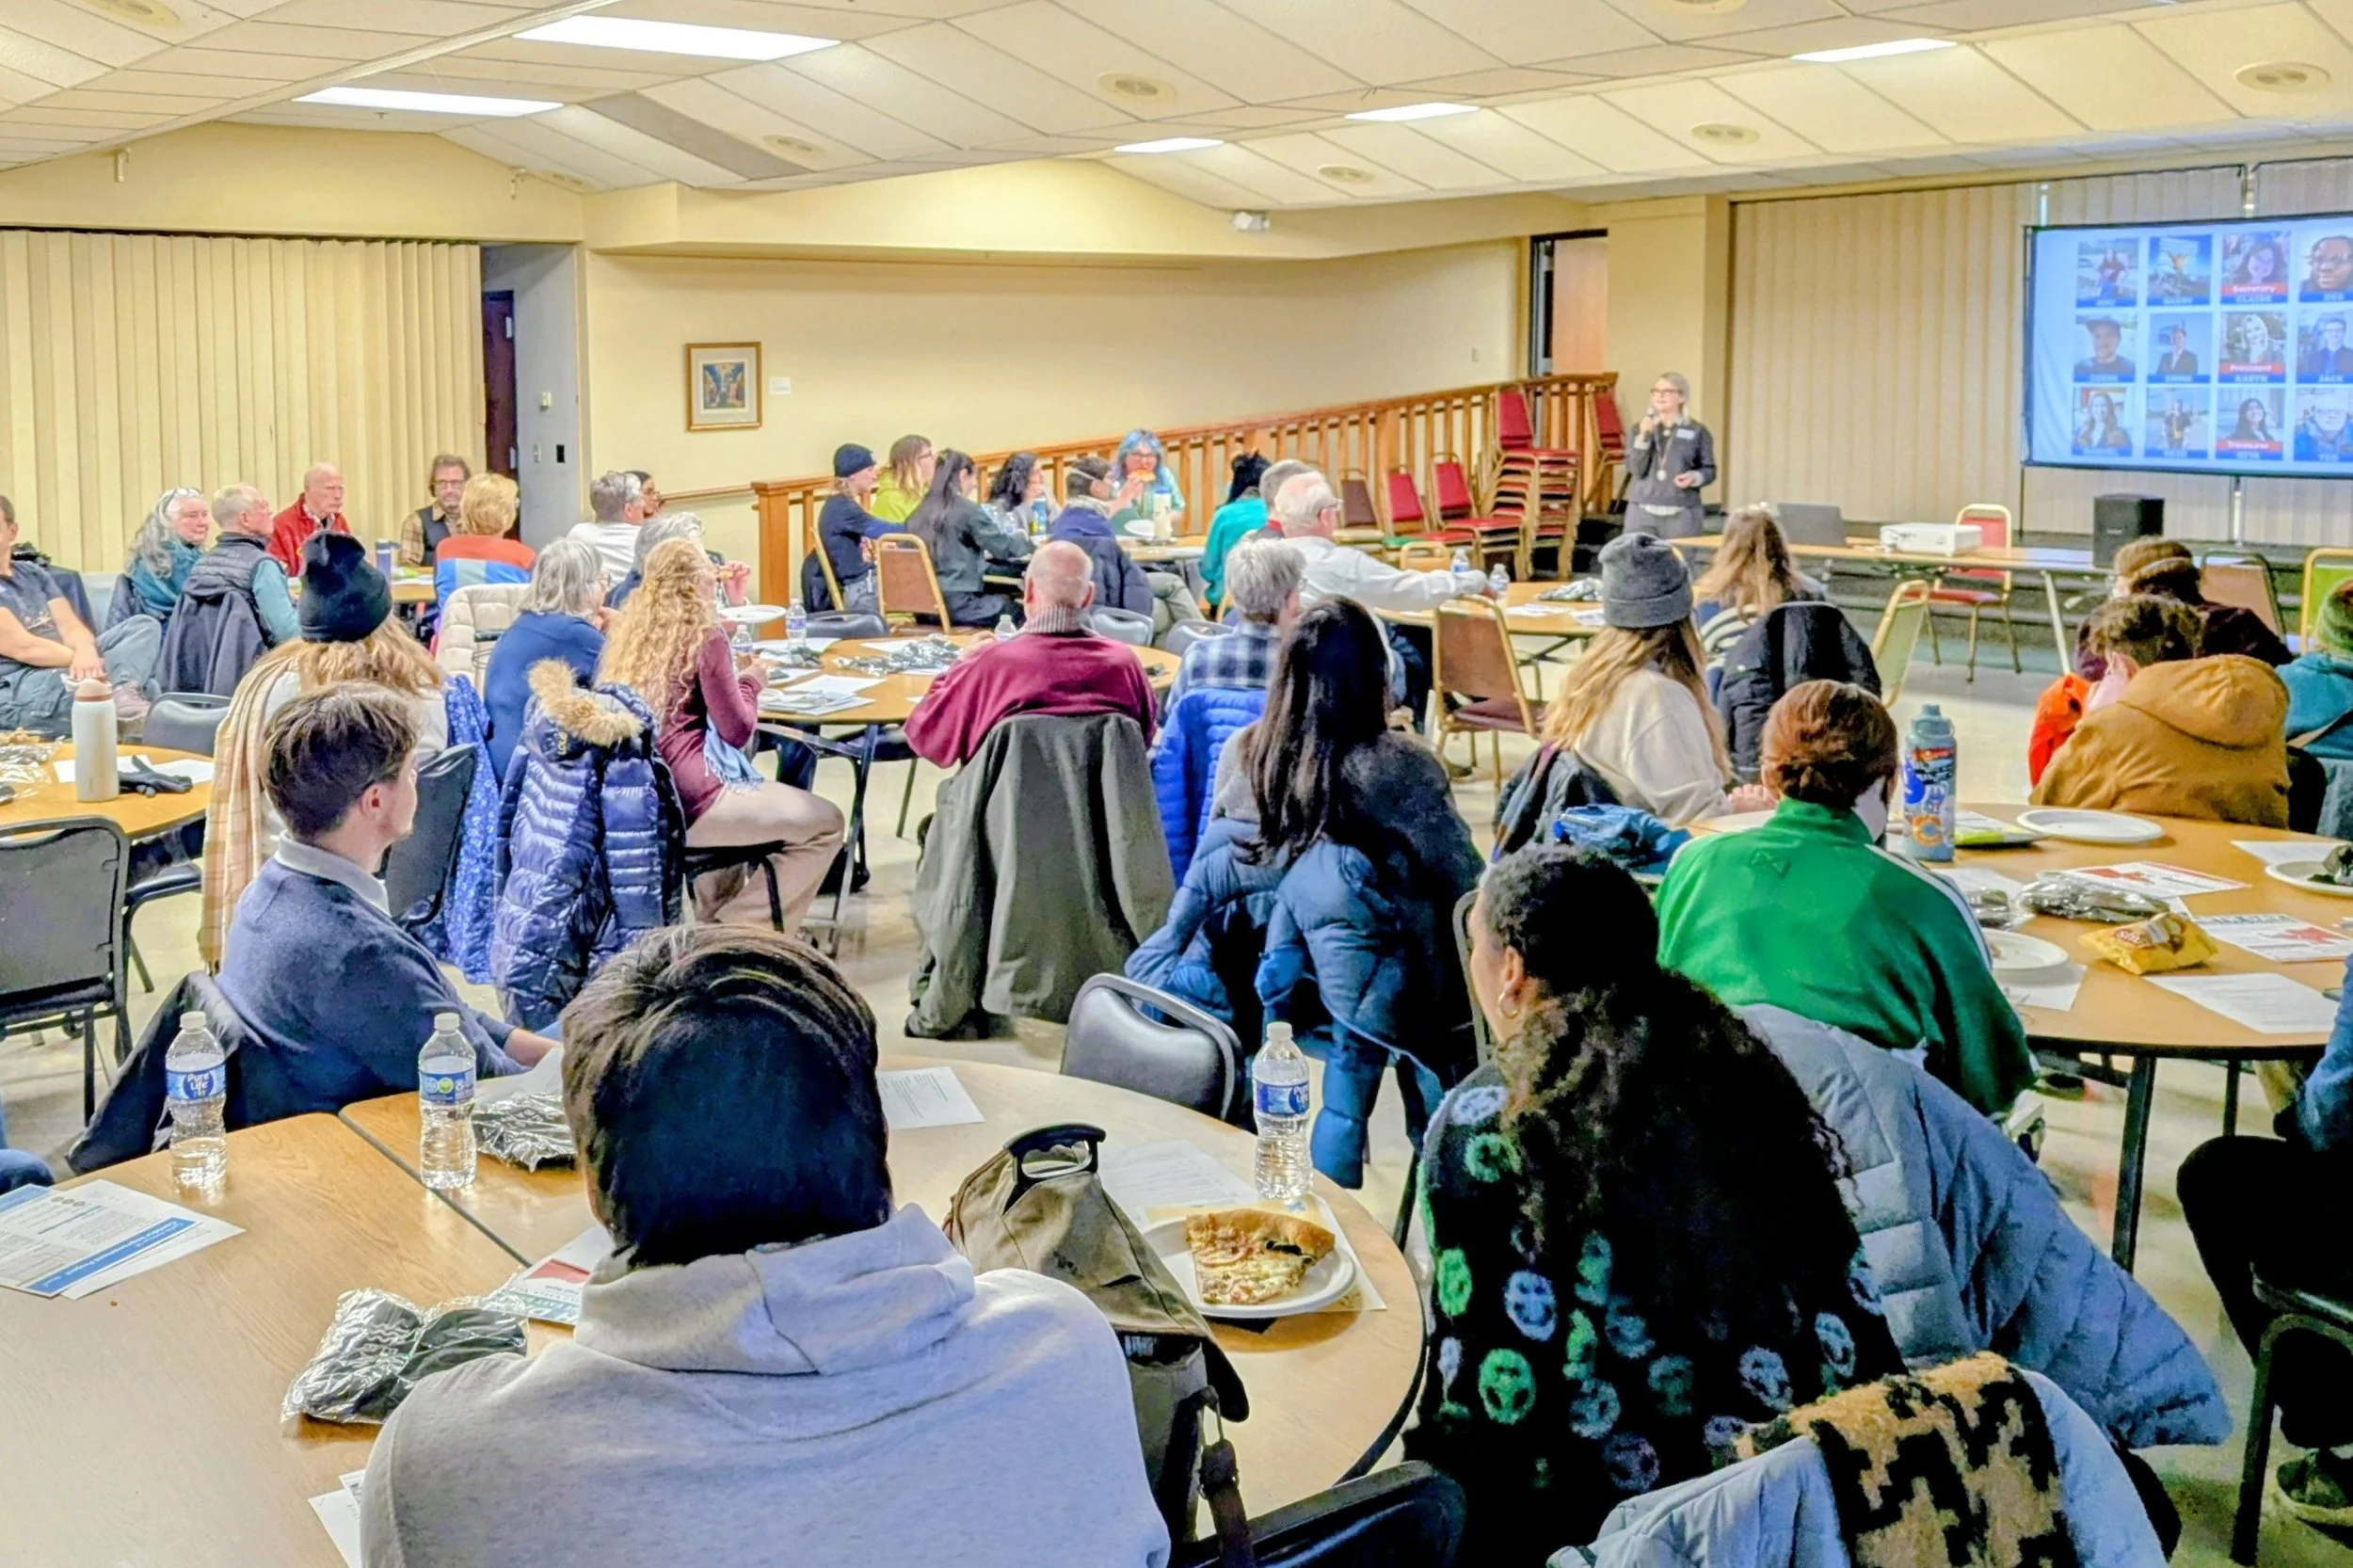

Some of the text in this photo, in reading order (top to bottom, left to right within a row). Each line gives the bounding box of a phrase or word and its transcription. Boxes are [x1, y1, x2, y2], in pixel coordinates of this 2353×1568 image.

[2233, 284, 2275, 295] Secretary
[2229, 363, 2272, 373] President
[187, 1072, 210, 1083] Pure
[190, 1080, 208, 1091] Life
